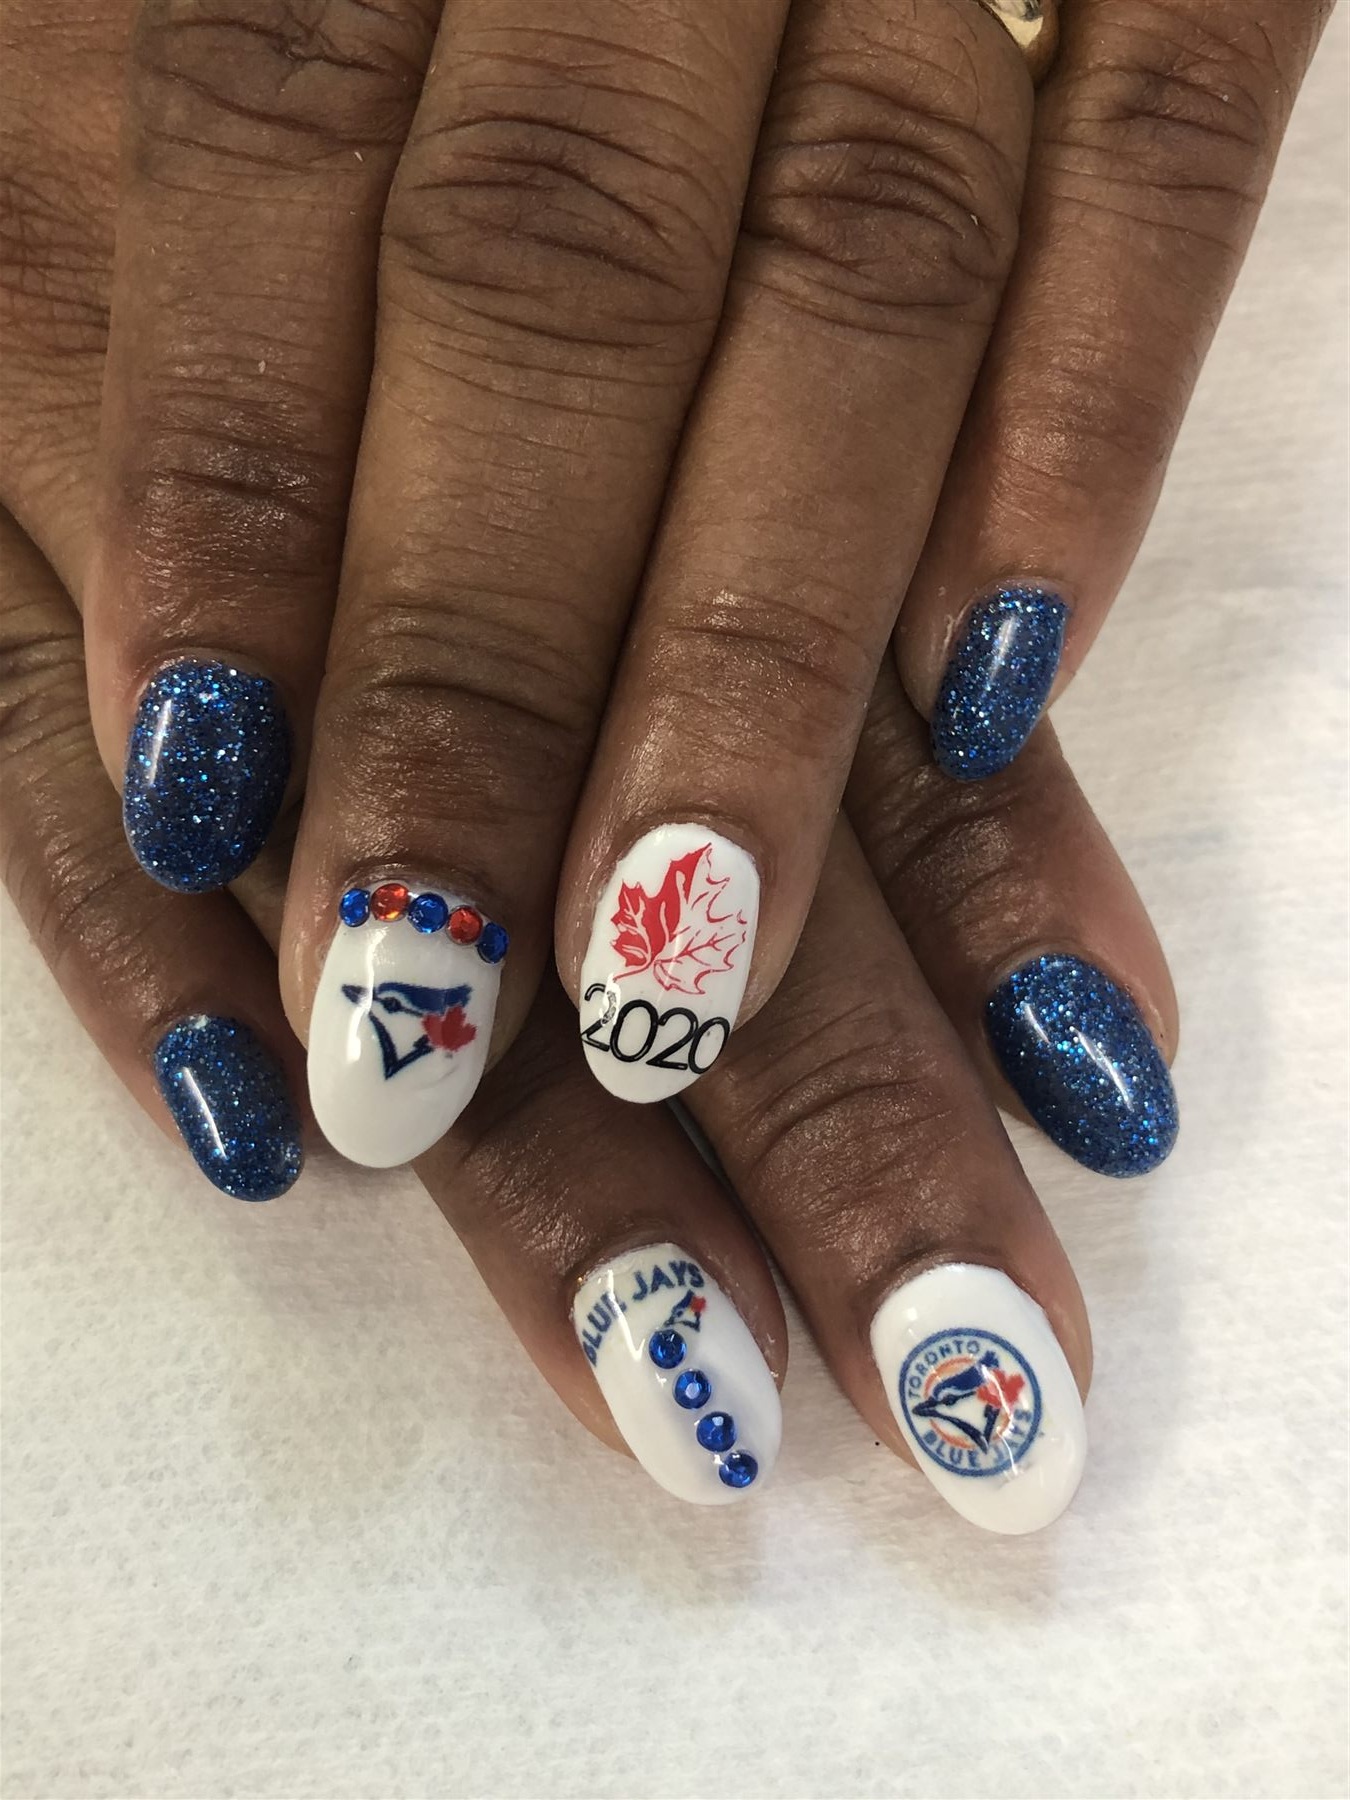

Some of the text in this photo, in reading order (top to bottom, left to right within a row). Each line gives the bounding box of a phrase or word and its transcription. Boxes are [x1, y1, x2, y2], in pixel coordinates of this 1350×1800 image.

[581, 983, 730, 1074] 2020
[632, 1260, 704, 1301] JAYS
[908, 1339, 980, 1399] TORONTO
[923, 1429, 981, 1467] BLUE
